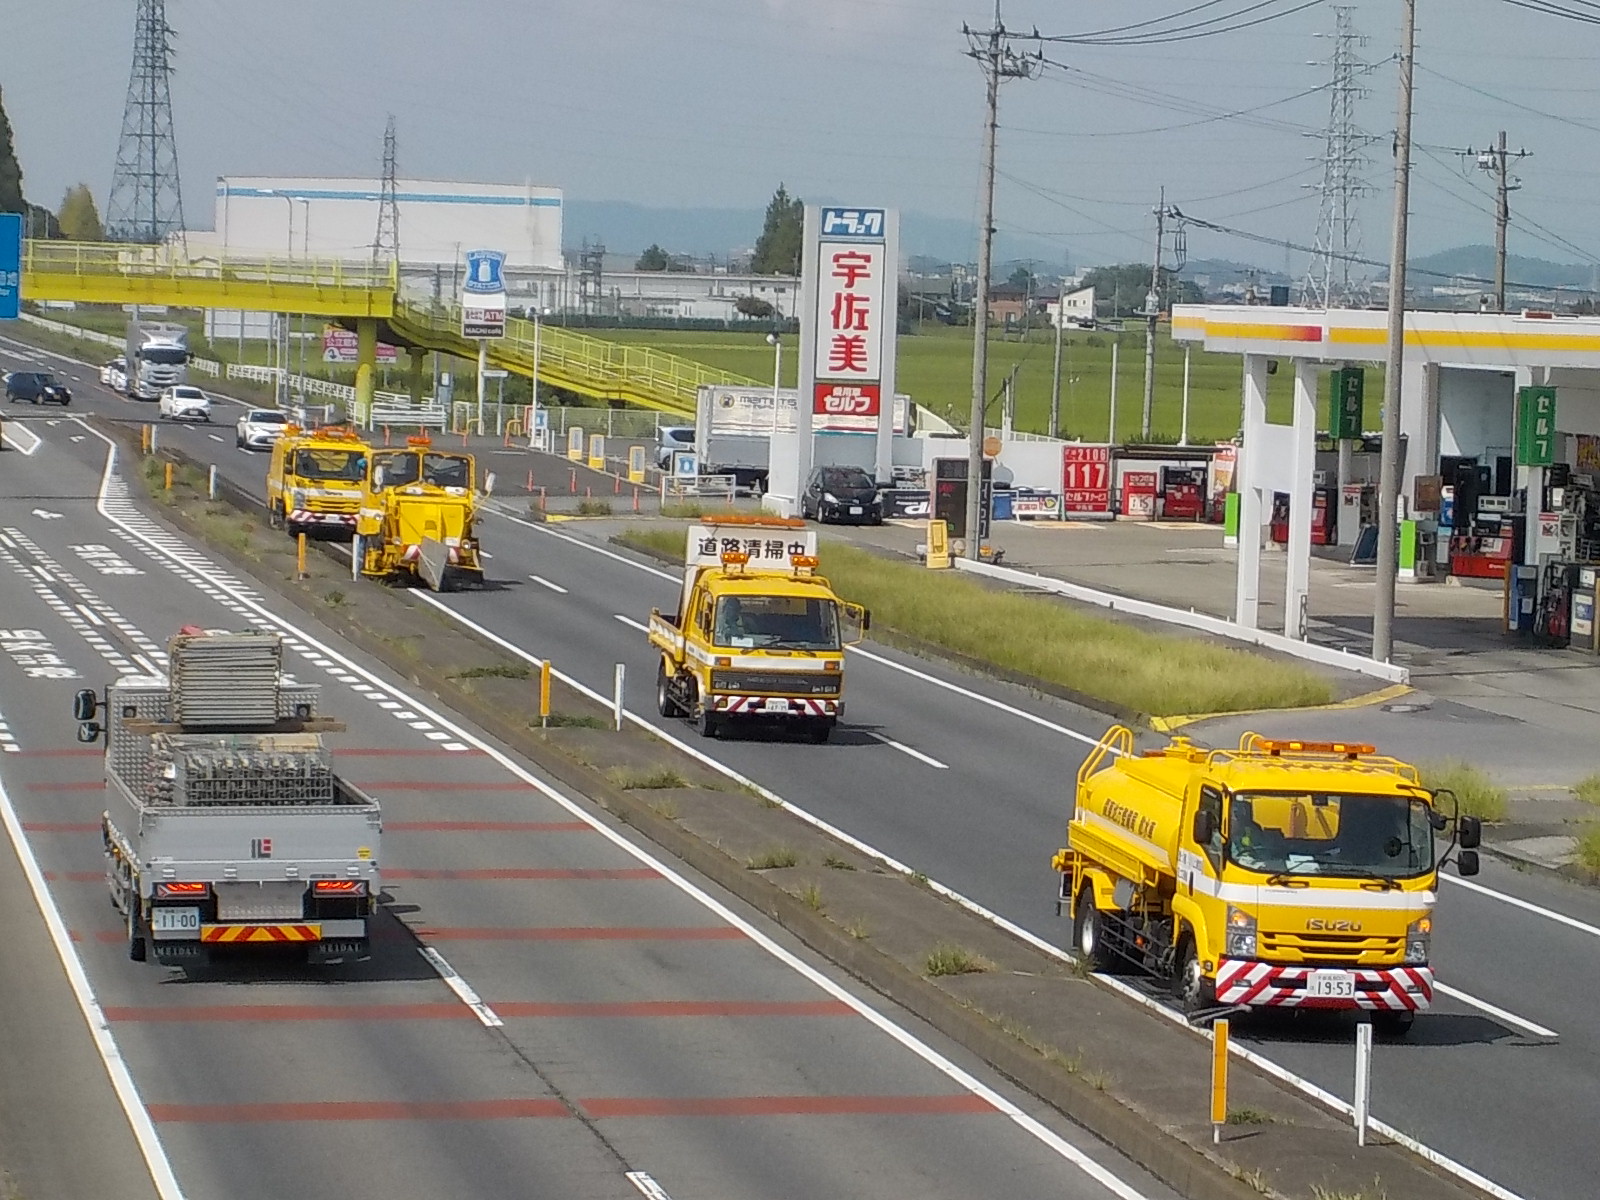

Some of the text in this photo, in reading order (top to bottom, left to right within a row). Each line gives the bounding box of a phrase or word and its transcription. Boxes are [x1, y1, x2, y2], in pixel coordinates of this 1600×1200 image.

[824, 211, 882, 234] トラック
[484, 311, 503, 321] ATM
[828, 251, 871, 372] 宇佐美
[824, 395, 870, 412] セルフ
[1345, 376, 1358, 431] セルフ
[1535, 396, 1549, 458] セルフ
[1077, 449, 1106, 461] 2106
[1067, 463, 1106, 488] 117
[698, 537, 805, 560] 道路清掃中
[1306, 919, 1362, 932] ISUZU
